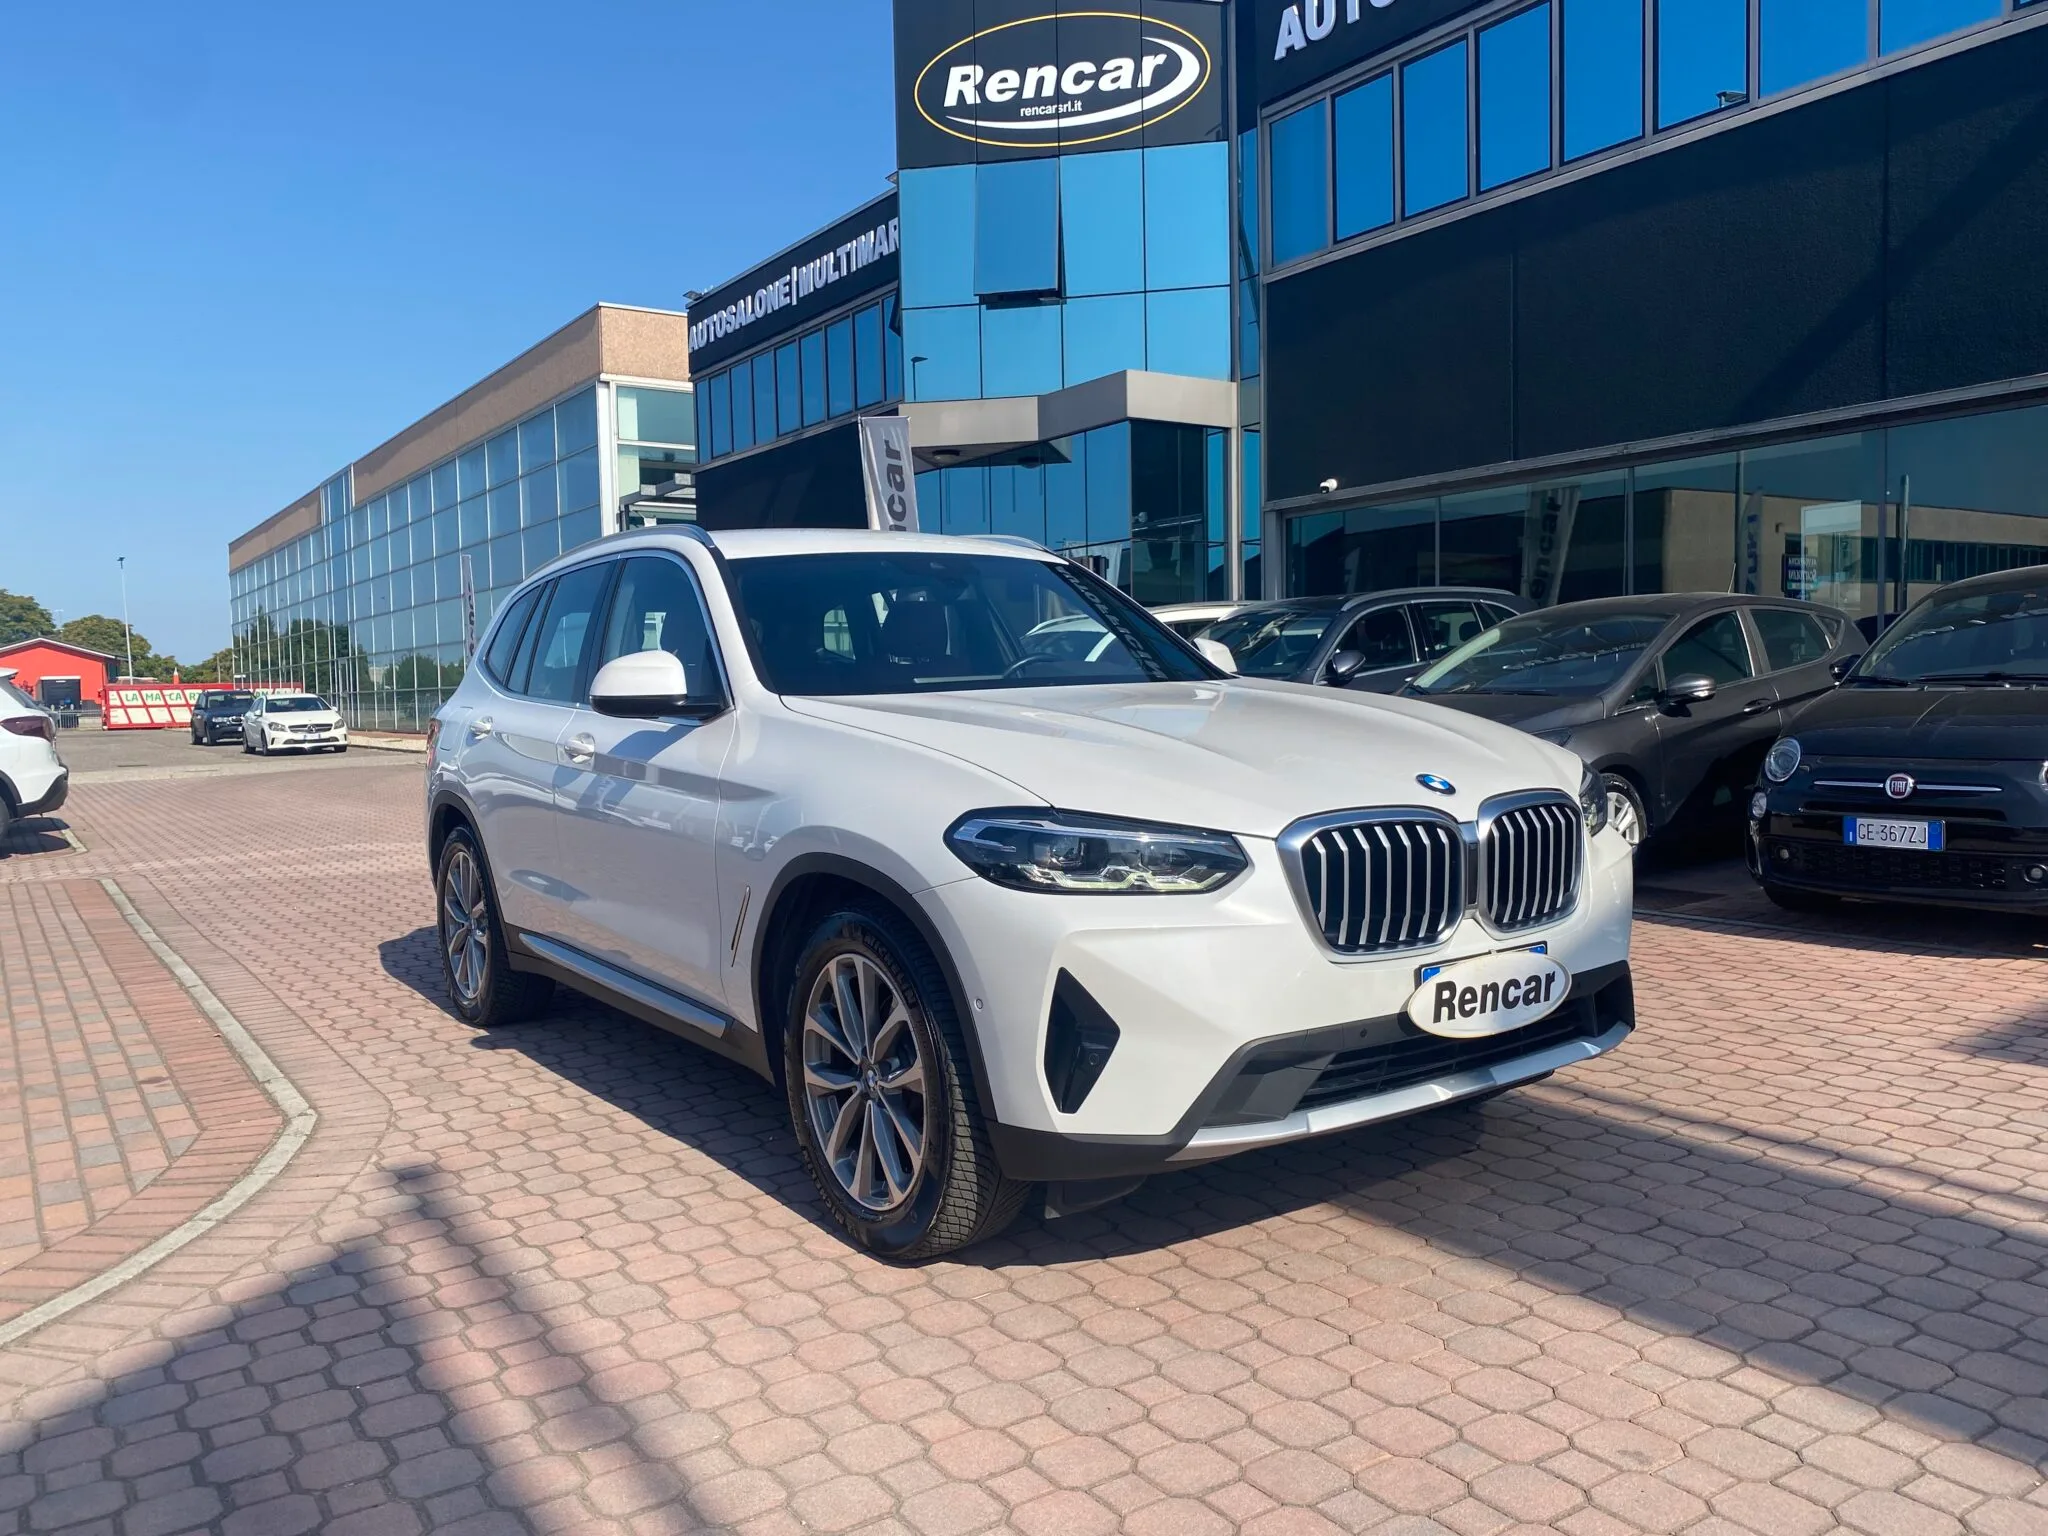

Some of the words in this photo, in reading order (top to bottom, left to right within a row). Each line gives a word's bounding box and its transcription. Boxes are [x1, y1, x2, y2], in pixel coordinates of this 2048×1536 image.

[943, 53, 1167, 108] Rencar
[1020, 100, 1083, 117] rencarsrl.it
[688, 273, 791, 353] AUTOSALONE
[884, 439, 907, 531] car
[1890, 780, 1907, 793] FIAT
[1432, 970, 1556, 1024] Rencar
